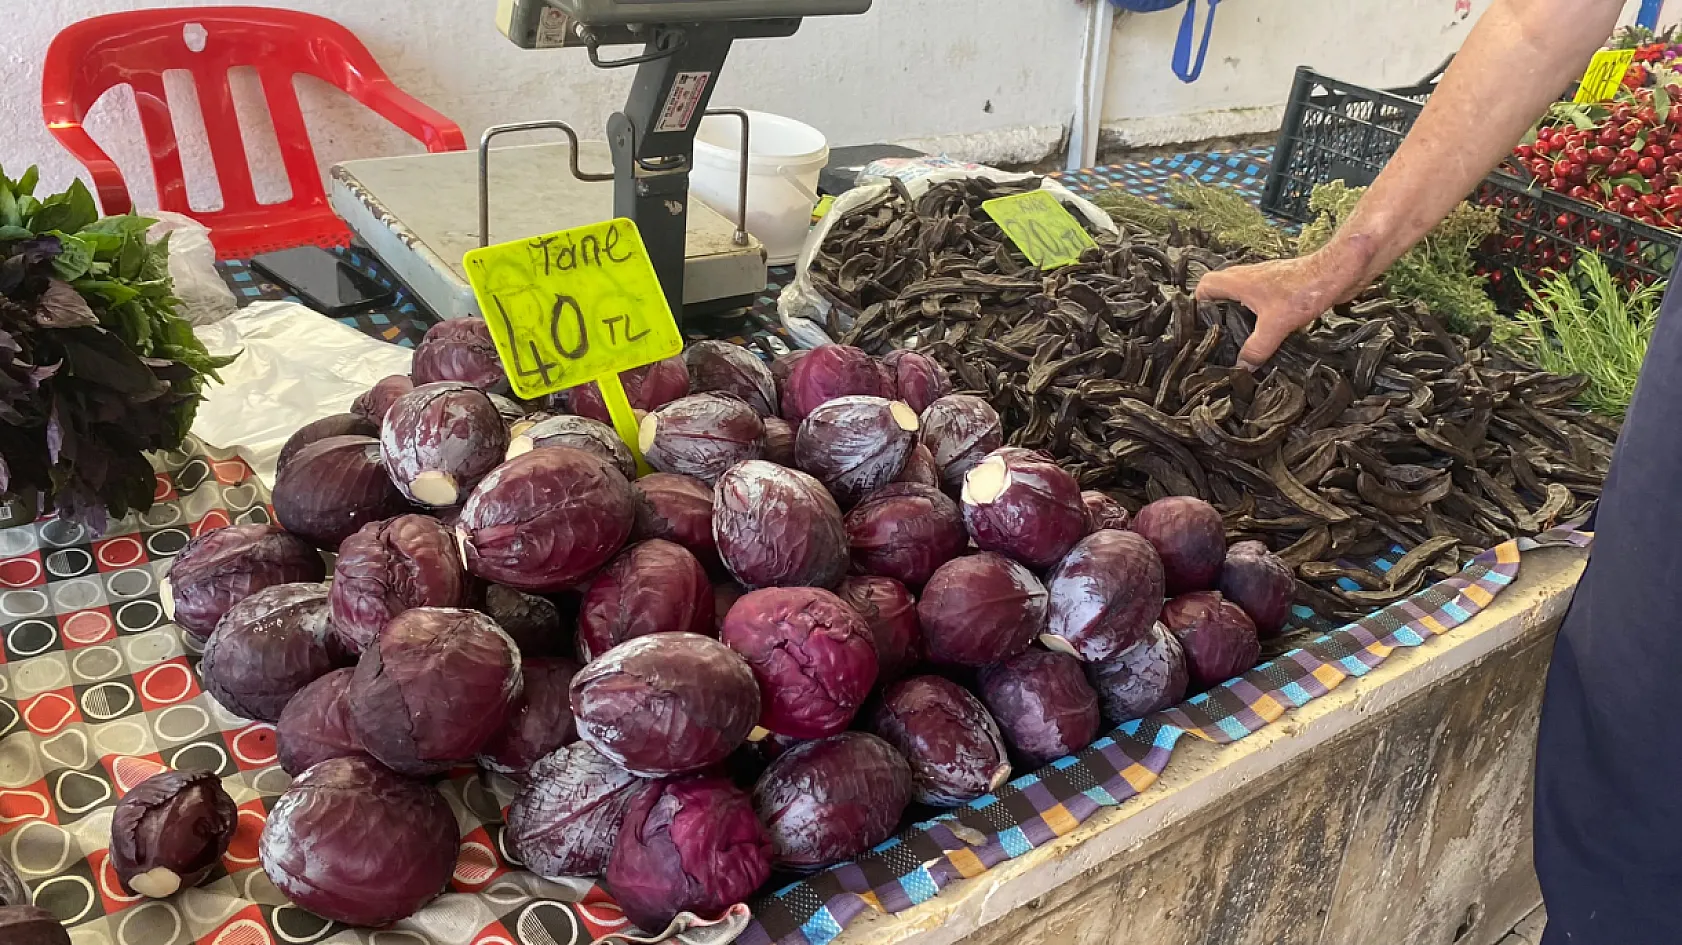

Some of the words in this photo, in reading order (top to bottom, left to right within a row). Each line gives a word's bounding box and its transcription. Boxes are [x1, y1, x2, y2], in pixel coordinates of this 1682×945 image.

[529, 224, 632, 276] Tane
[492, 294, 589, 387] 40
[602, 313, 651, 345] TL
